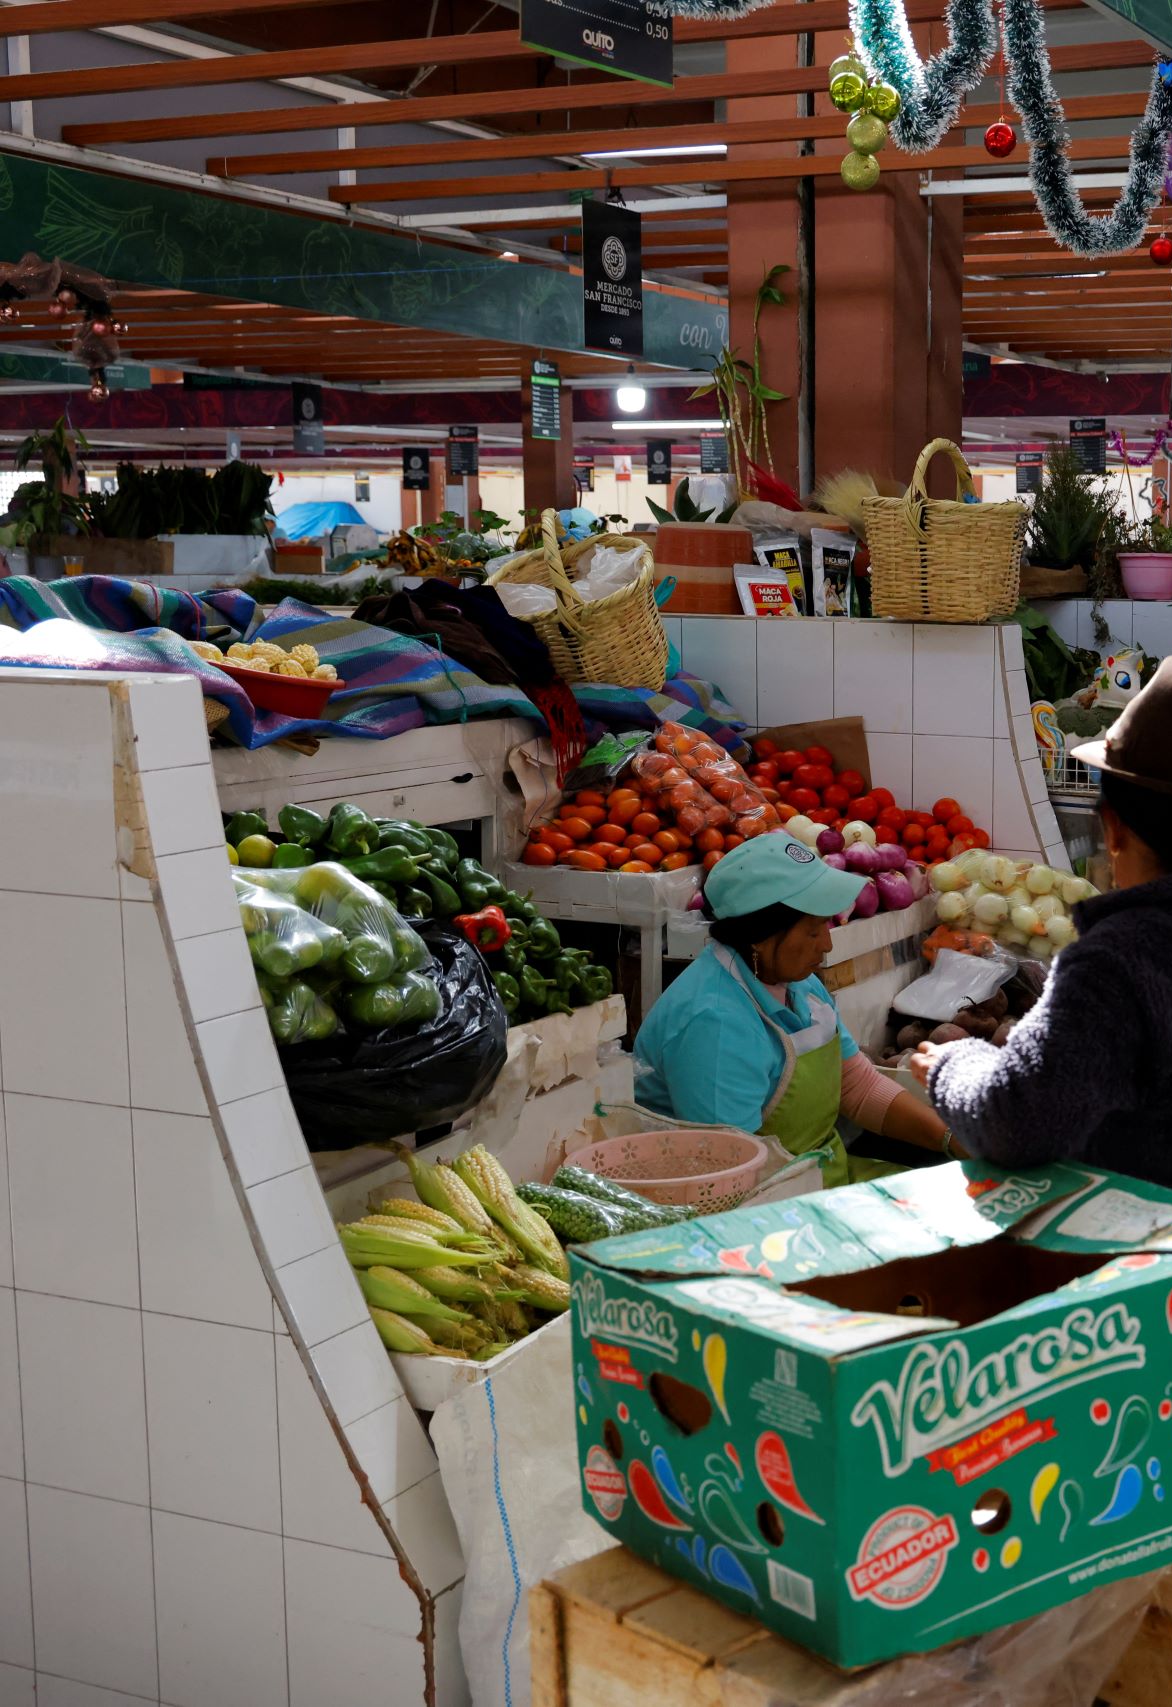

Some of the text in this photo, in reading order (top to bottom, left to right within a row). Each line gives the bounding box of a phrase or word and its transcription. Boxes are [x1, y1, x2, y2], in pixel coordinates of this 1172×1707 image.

[582, 29, 614, 51] QUITO
[646, 22, 668, 40] 0,50
[596, 281, 633, 297] MERCADO
[584, 289, 642, 311] SAN FRANCISCO
[600, 303, 618, 315] DESDE
[679, 323, 713, 349] con
[774, 551, 790, 559] MACA
[759, 587, 782, 596] MACA
[762, 595, 783, 603] ROJA
[573, 1271, 679, 1342] Velarosa
[850, 1302, 1141, 1478] Velarosa
[853, 1523, 950, 1589] ECUADOR
